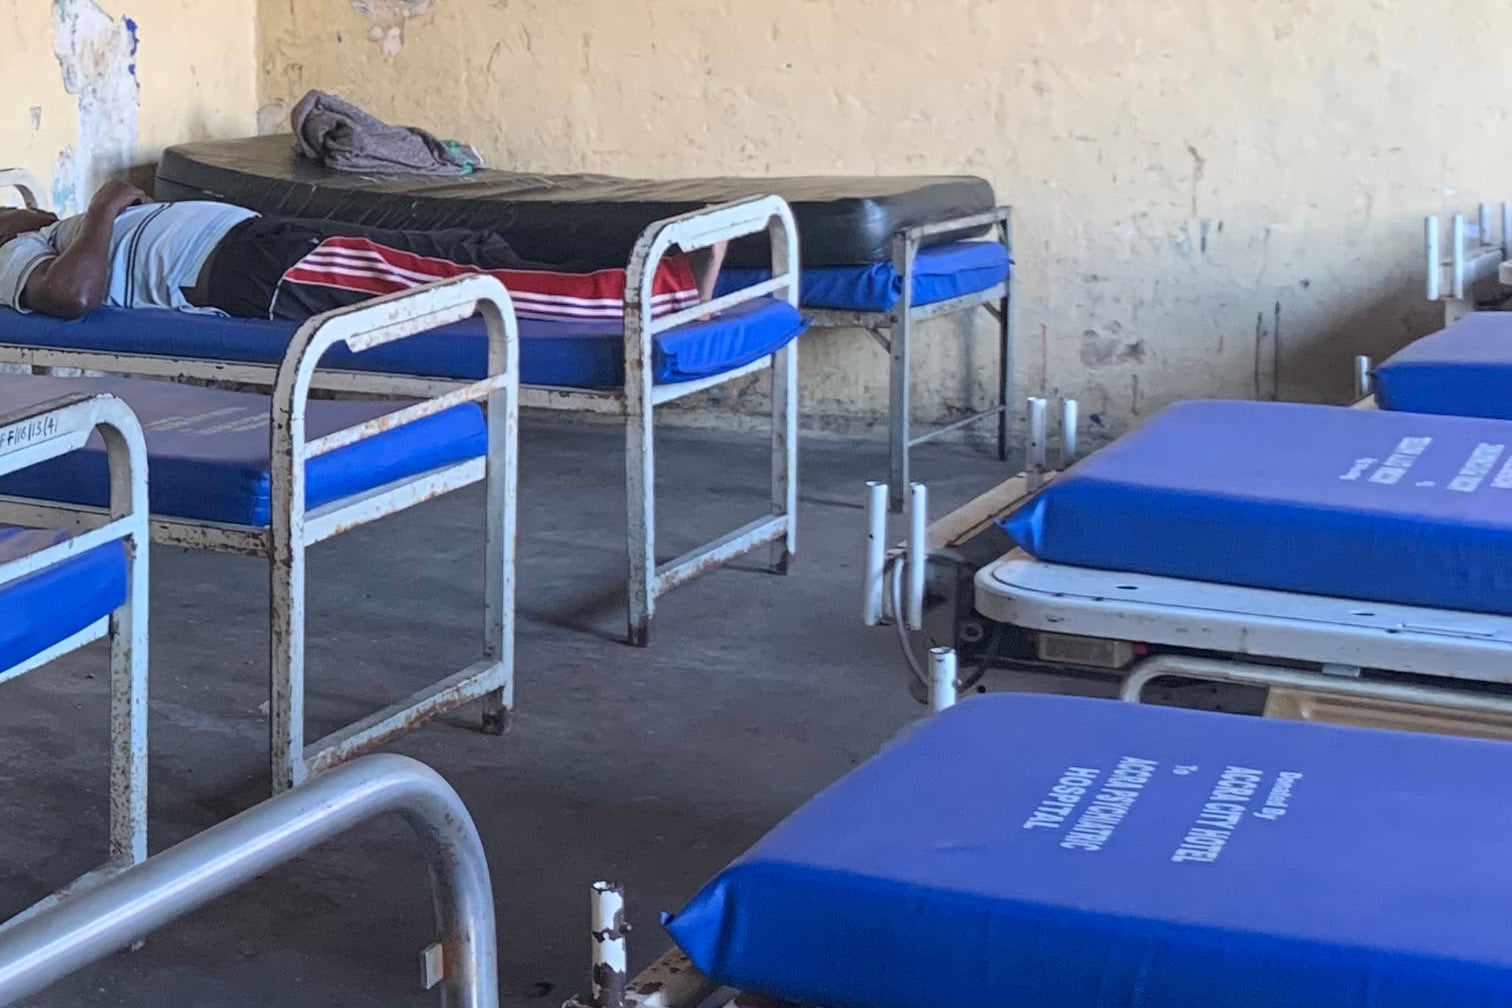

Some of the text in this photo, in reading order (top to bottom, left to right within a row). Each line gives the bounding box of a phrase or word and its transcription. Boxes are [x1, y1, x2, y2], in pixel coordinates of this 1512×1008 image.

[1022, 765, 1101, 829] HOSPITAL
[1059, 755, 1159, 851] ACCRA PSYCHIATRIC
[1170, 765, 1263, 863] ACCRA CITY HOTEL
